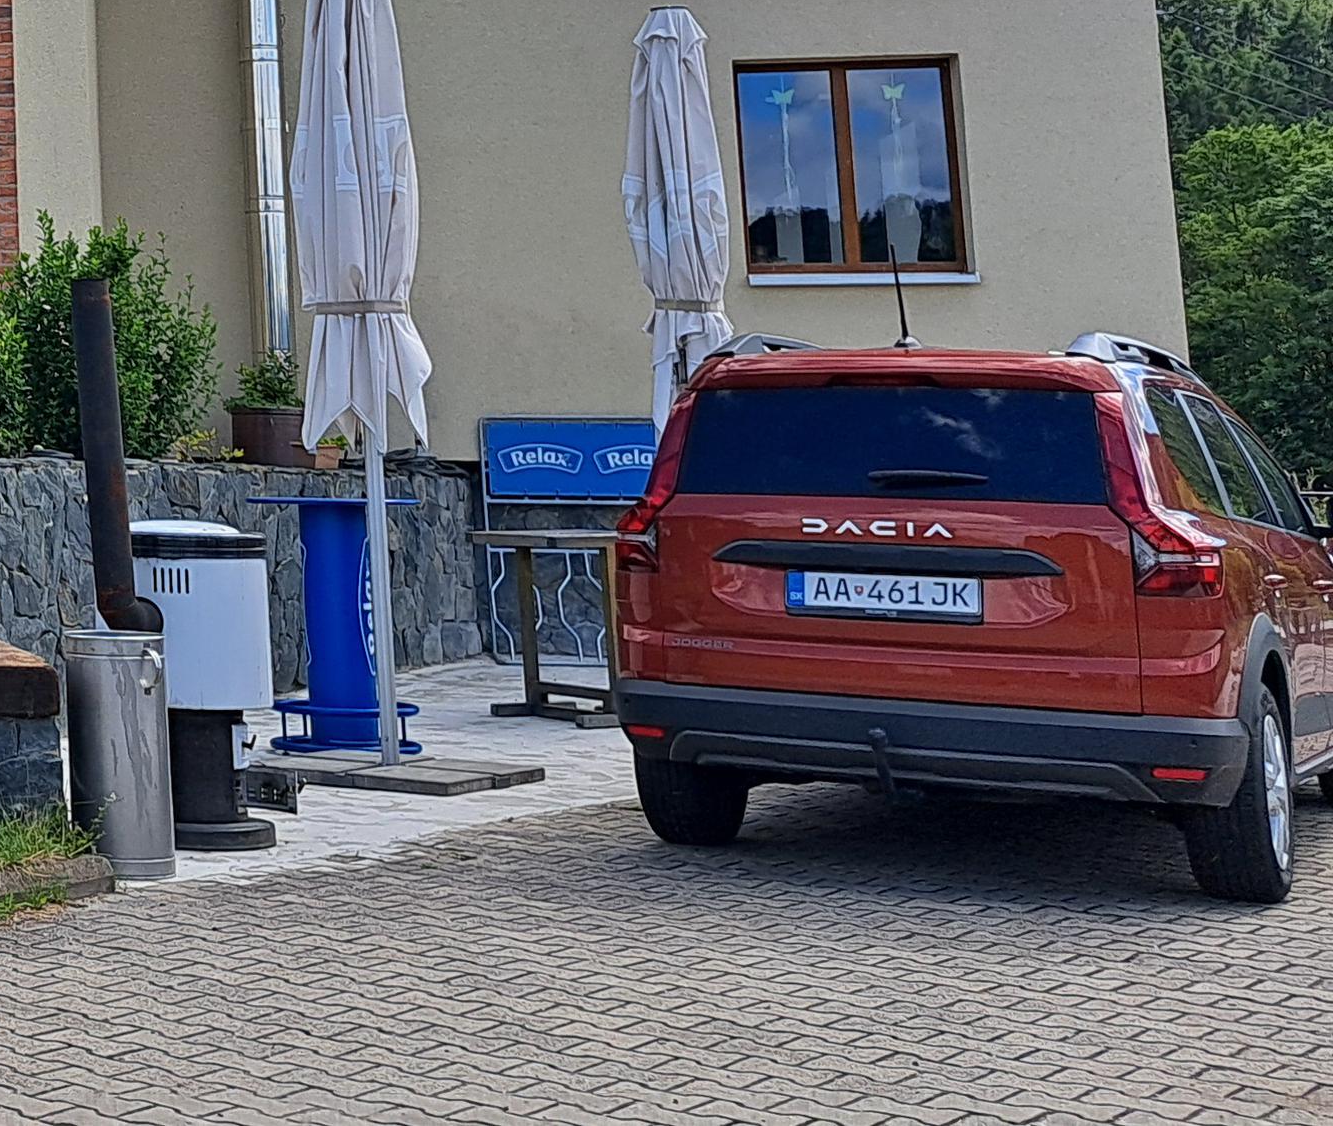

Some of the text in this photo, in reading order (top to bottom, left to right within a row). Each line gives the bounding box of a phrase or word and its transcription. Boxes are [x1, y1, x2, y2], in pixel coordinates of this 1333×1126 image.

[510, 447, 570, 467] Relax
[801, 517, 954, 539] DACIA
[789, 591, 804, 601] SK
[813, 576, 851, 603] AA
[672, 637, 734, 651] JOGGER
